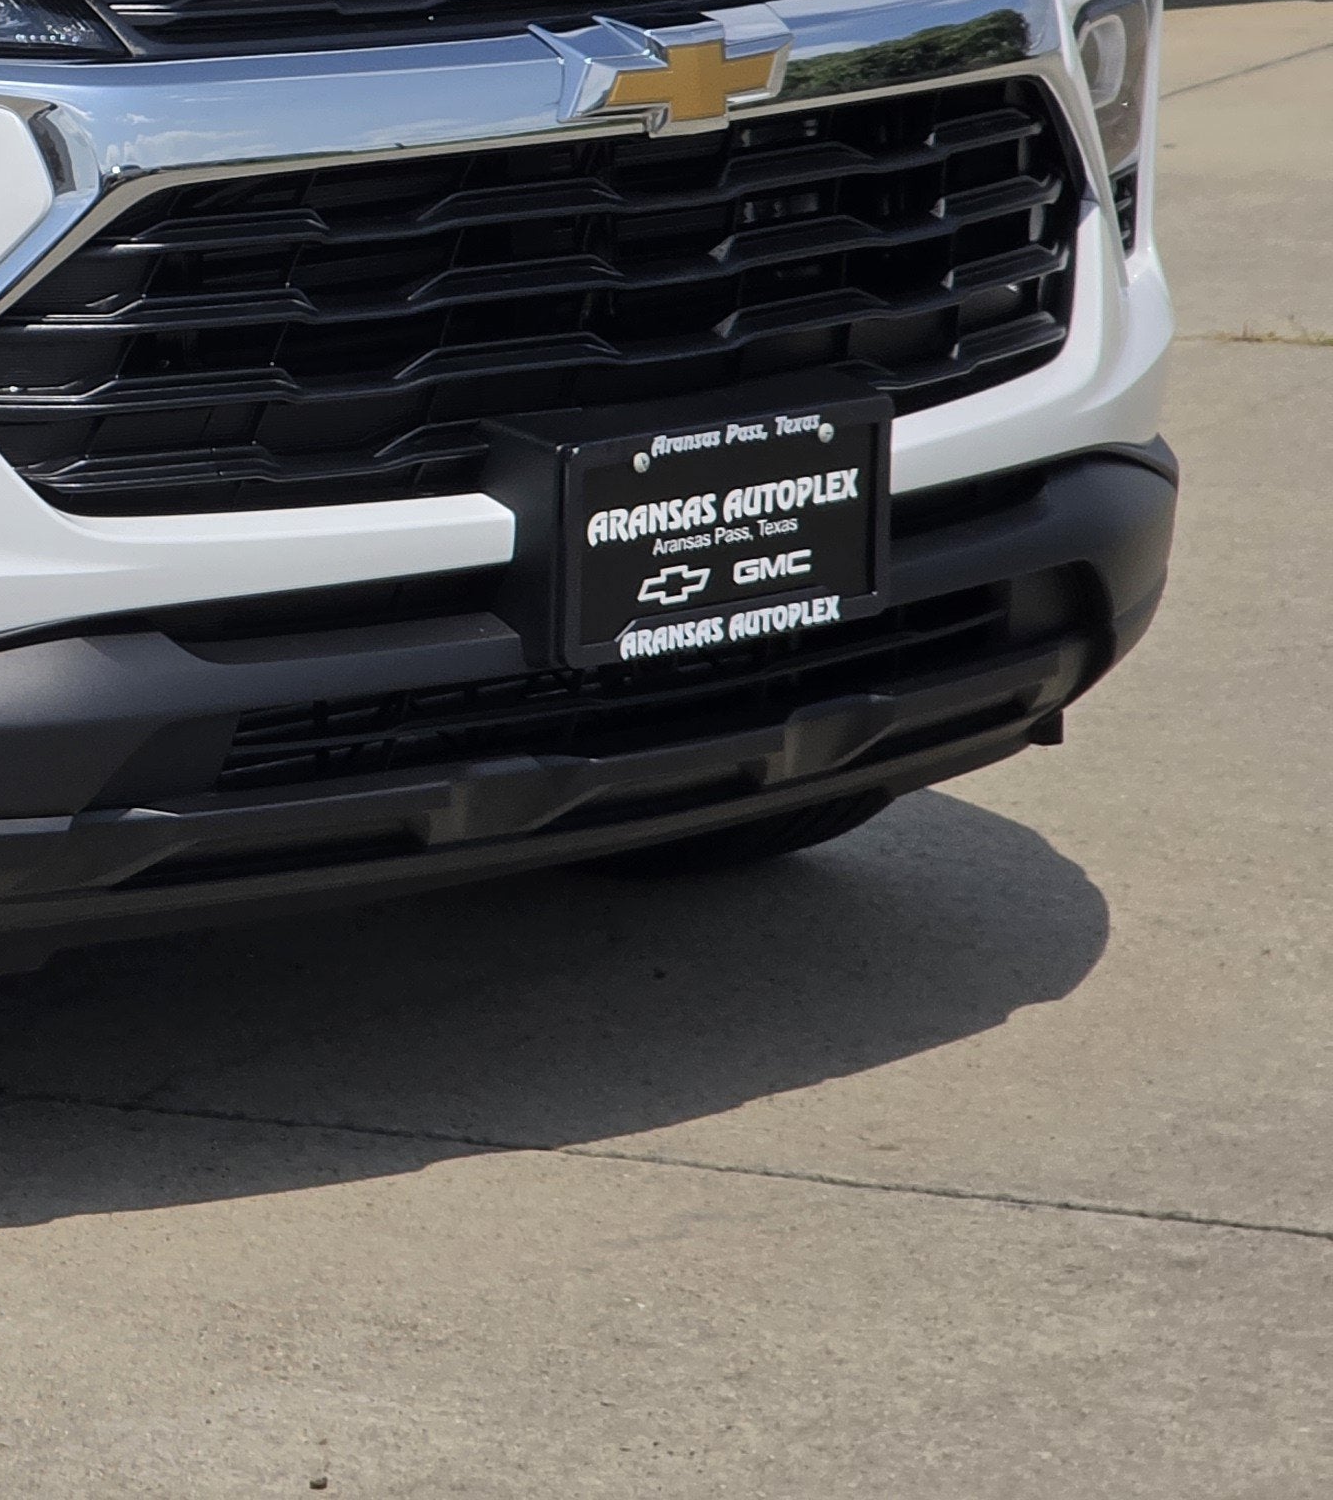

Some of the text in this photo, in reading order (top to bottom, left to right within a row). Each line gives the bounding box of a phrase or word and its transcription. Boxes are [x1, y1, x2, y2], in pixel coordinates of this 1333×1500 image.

[651, 414, 821, 457] Aransas Pass, Texas
[587, 468, 859, 547] ARANSAS AUTOPLEX
[652, 516, 798, 557] Aransas Pass, Texas
[733, 548, 812, 585] GMC
[620, 595, 840, 660] ARANSAS AUTOPLEX
